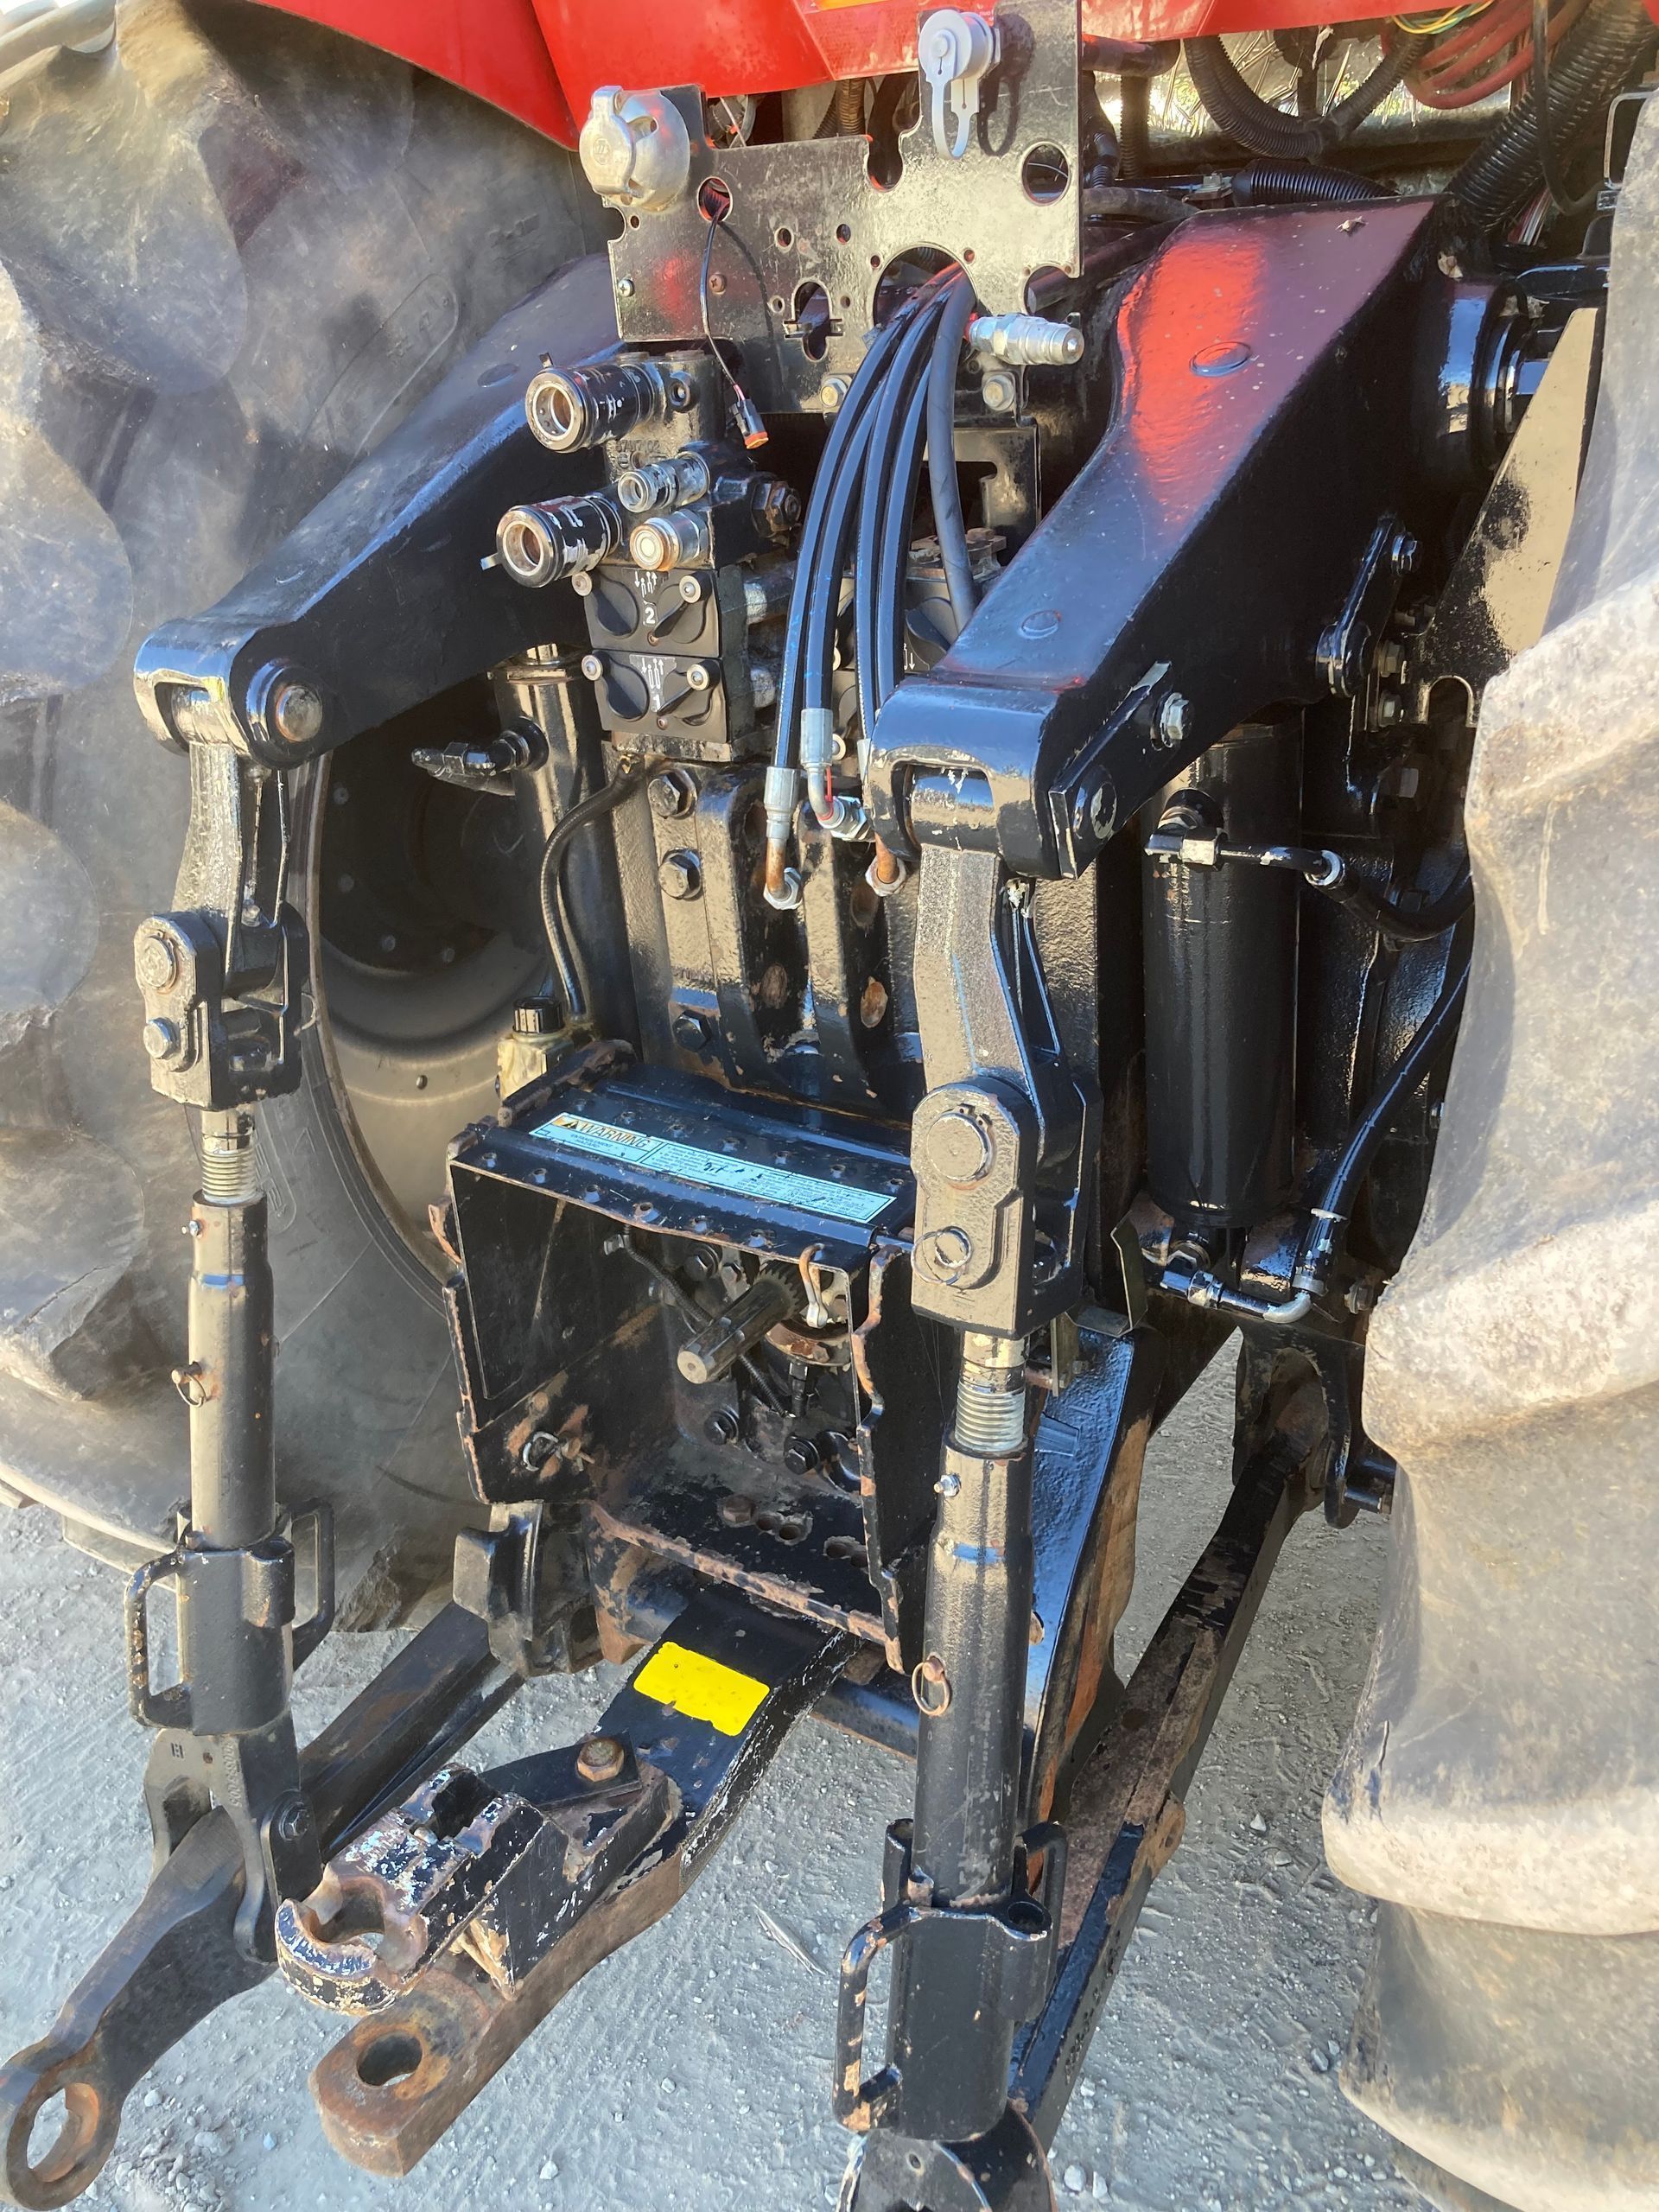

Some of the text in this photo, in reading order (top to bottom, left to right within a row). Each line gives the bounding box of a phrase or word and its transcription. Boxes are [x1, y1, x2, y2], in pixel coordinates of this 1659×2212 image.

[645, 607, 656, 625] 2
[652, 695, 661, 710] 1
[580, 1123, 650, 1147] WARNING
